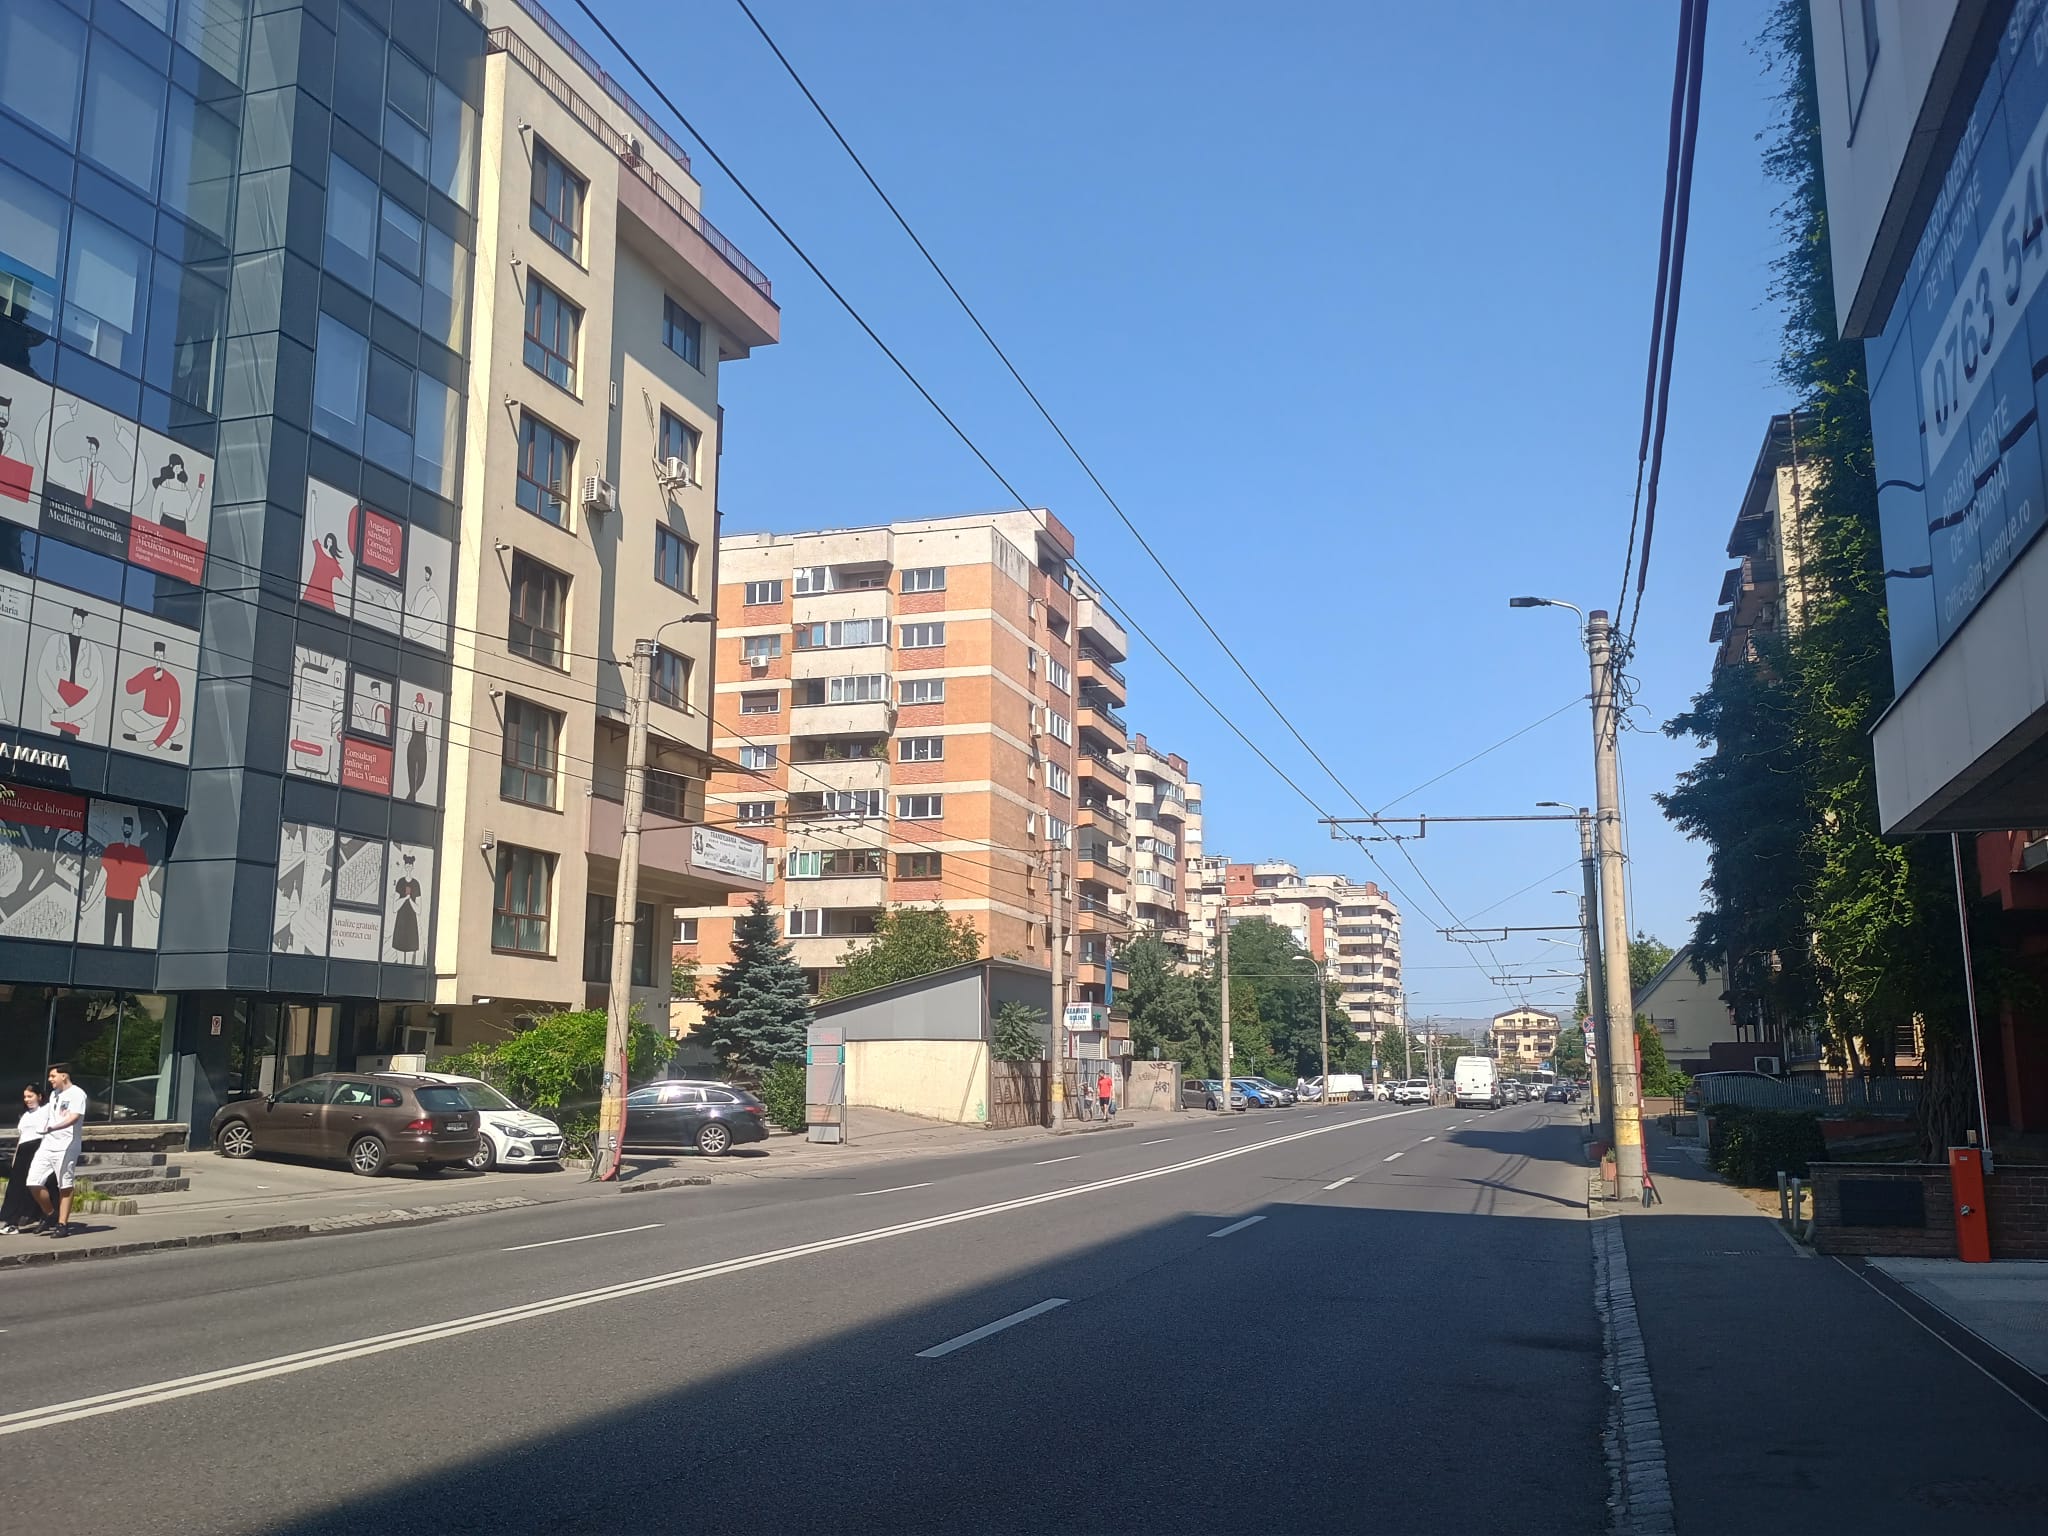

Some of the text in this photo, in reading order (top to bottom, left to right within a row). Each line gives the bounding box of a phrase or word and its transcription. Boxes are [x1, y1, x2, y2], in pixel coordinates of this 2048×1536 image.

[1917, 111, 1979, 281] APARTAMENTE
[1926, 269, 1939, 312] DE
[1933, 267, 1995, 437] 0763
[1942, 394, 2010, 526] APARTAMENTE
[1950, 527, 1964, 564] DE
[13, 745, 71, 771] MARIA
[33, 801, 44, 812] de
[45, 802, 83, 819] laborator
